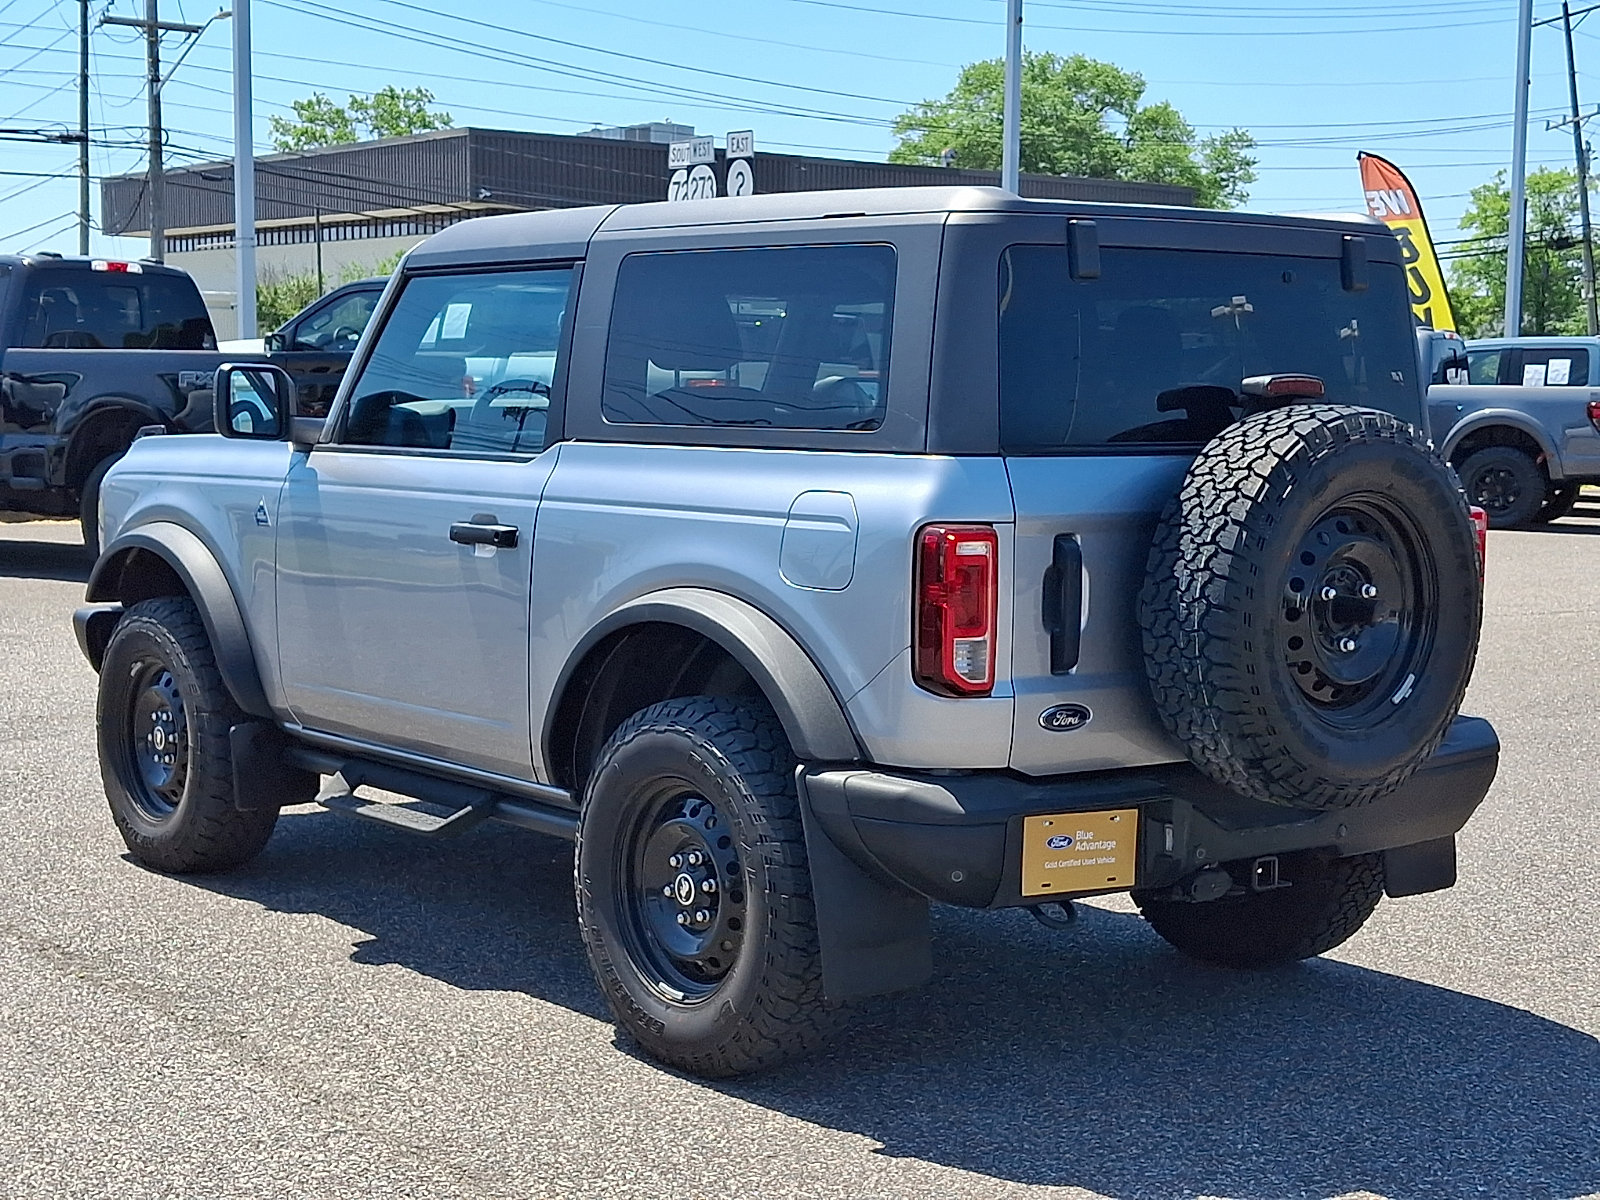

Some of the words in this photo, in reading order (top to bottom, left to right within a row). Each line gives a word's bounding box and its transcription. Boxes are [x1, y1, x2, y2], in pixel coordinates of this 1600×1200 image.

[693, 141, 710, 158] WEST
[731, 137, 749, 153] EAST
[671, 147, 690, 163] SOUT
[178, 370, 214, 387] FX
[1052, 710, 1081, 726] Ford
[1050, 836, 1070, 848] Ford
[1075, 830, 1094, 840] Blue
[1074, 840, 1117, 851] Advantage
